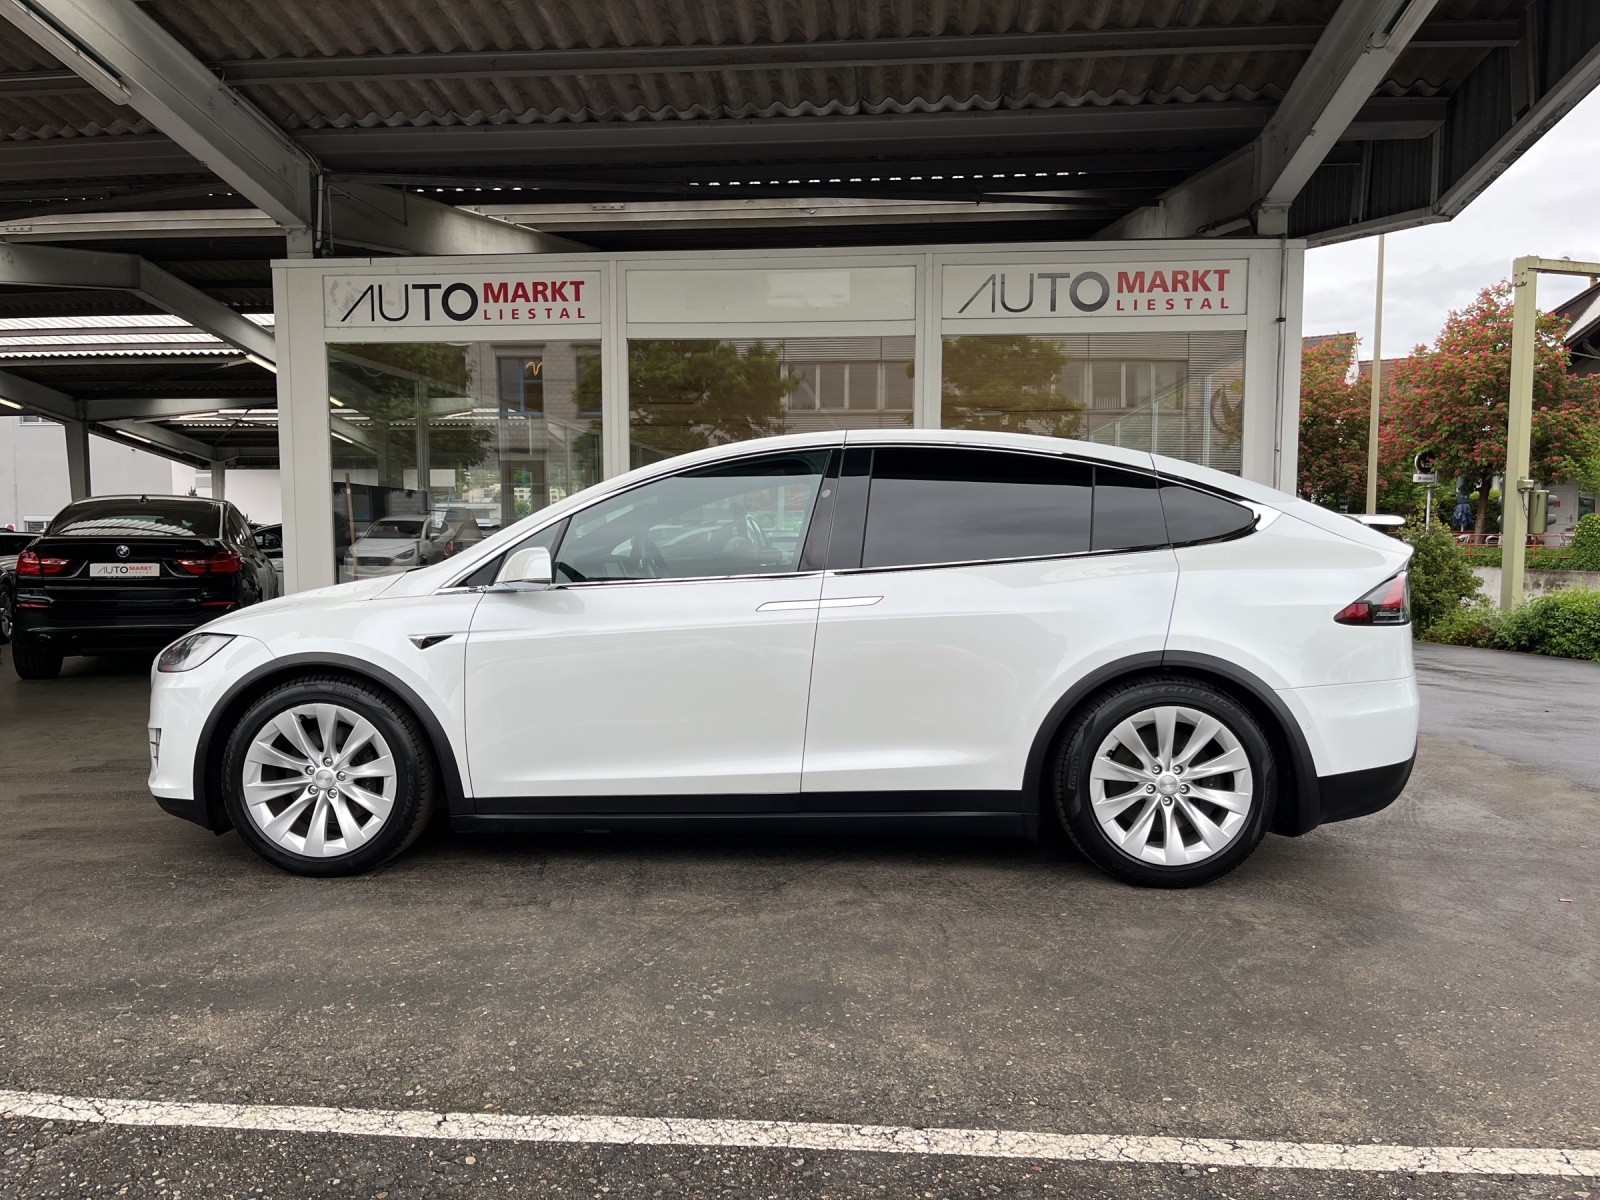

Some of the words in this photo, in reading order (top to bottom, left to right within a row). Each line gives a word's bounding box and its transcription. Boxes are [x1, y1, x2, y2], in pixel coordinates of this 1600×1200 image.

[958, 271, 1110, 313] AUTO
[1117, 269, 1231, 293] MARKT
[341, 282, 479, 322] AUTO
[483, 281, 585, 303] MARKT
[1117, 298, 1229, 311] LIESTAL
[483, 307, 585, 320] LIESTAL
[98, 566, 128, 574] AUTO
